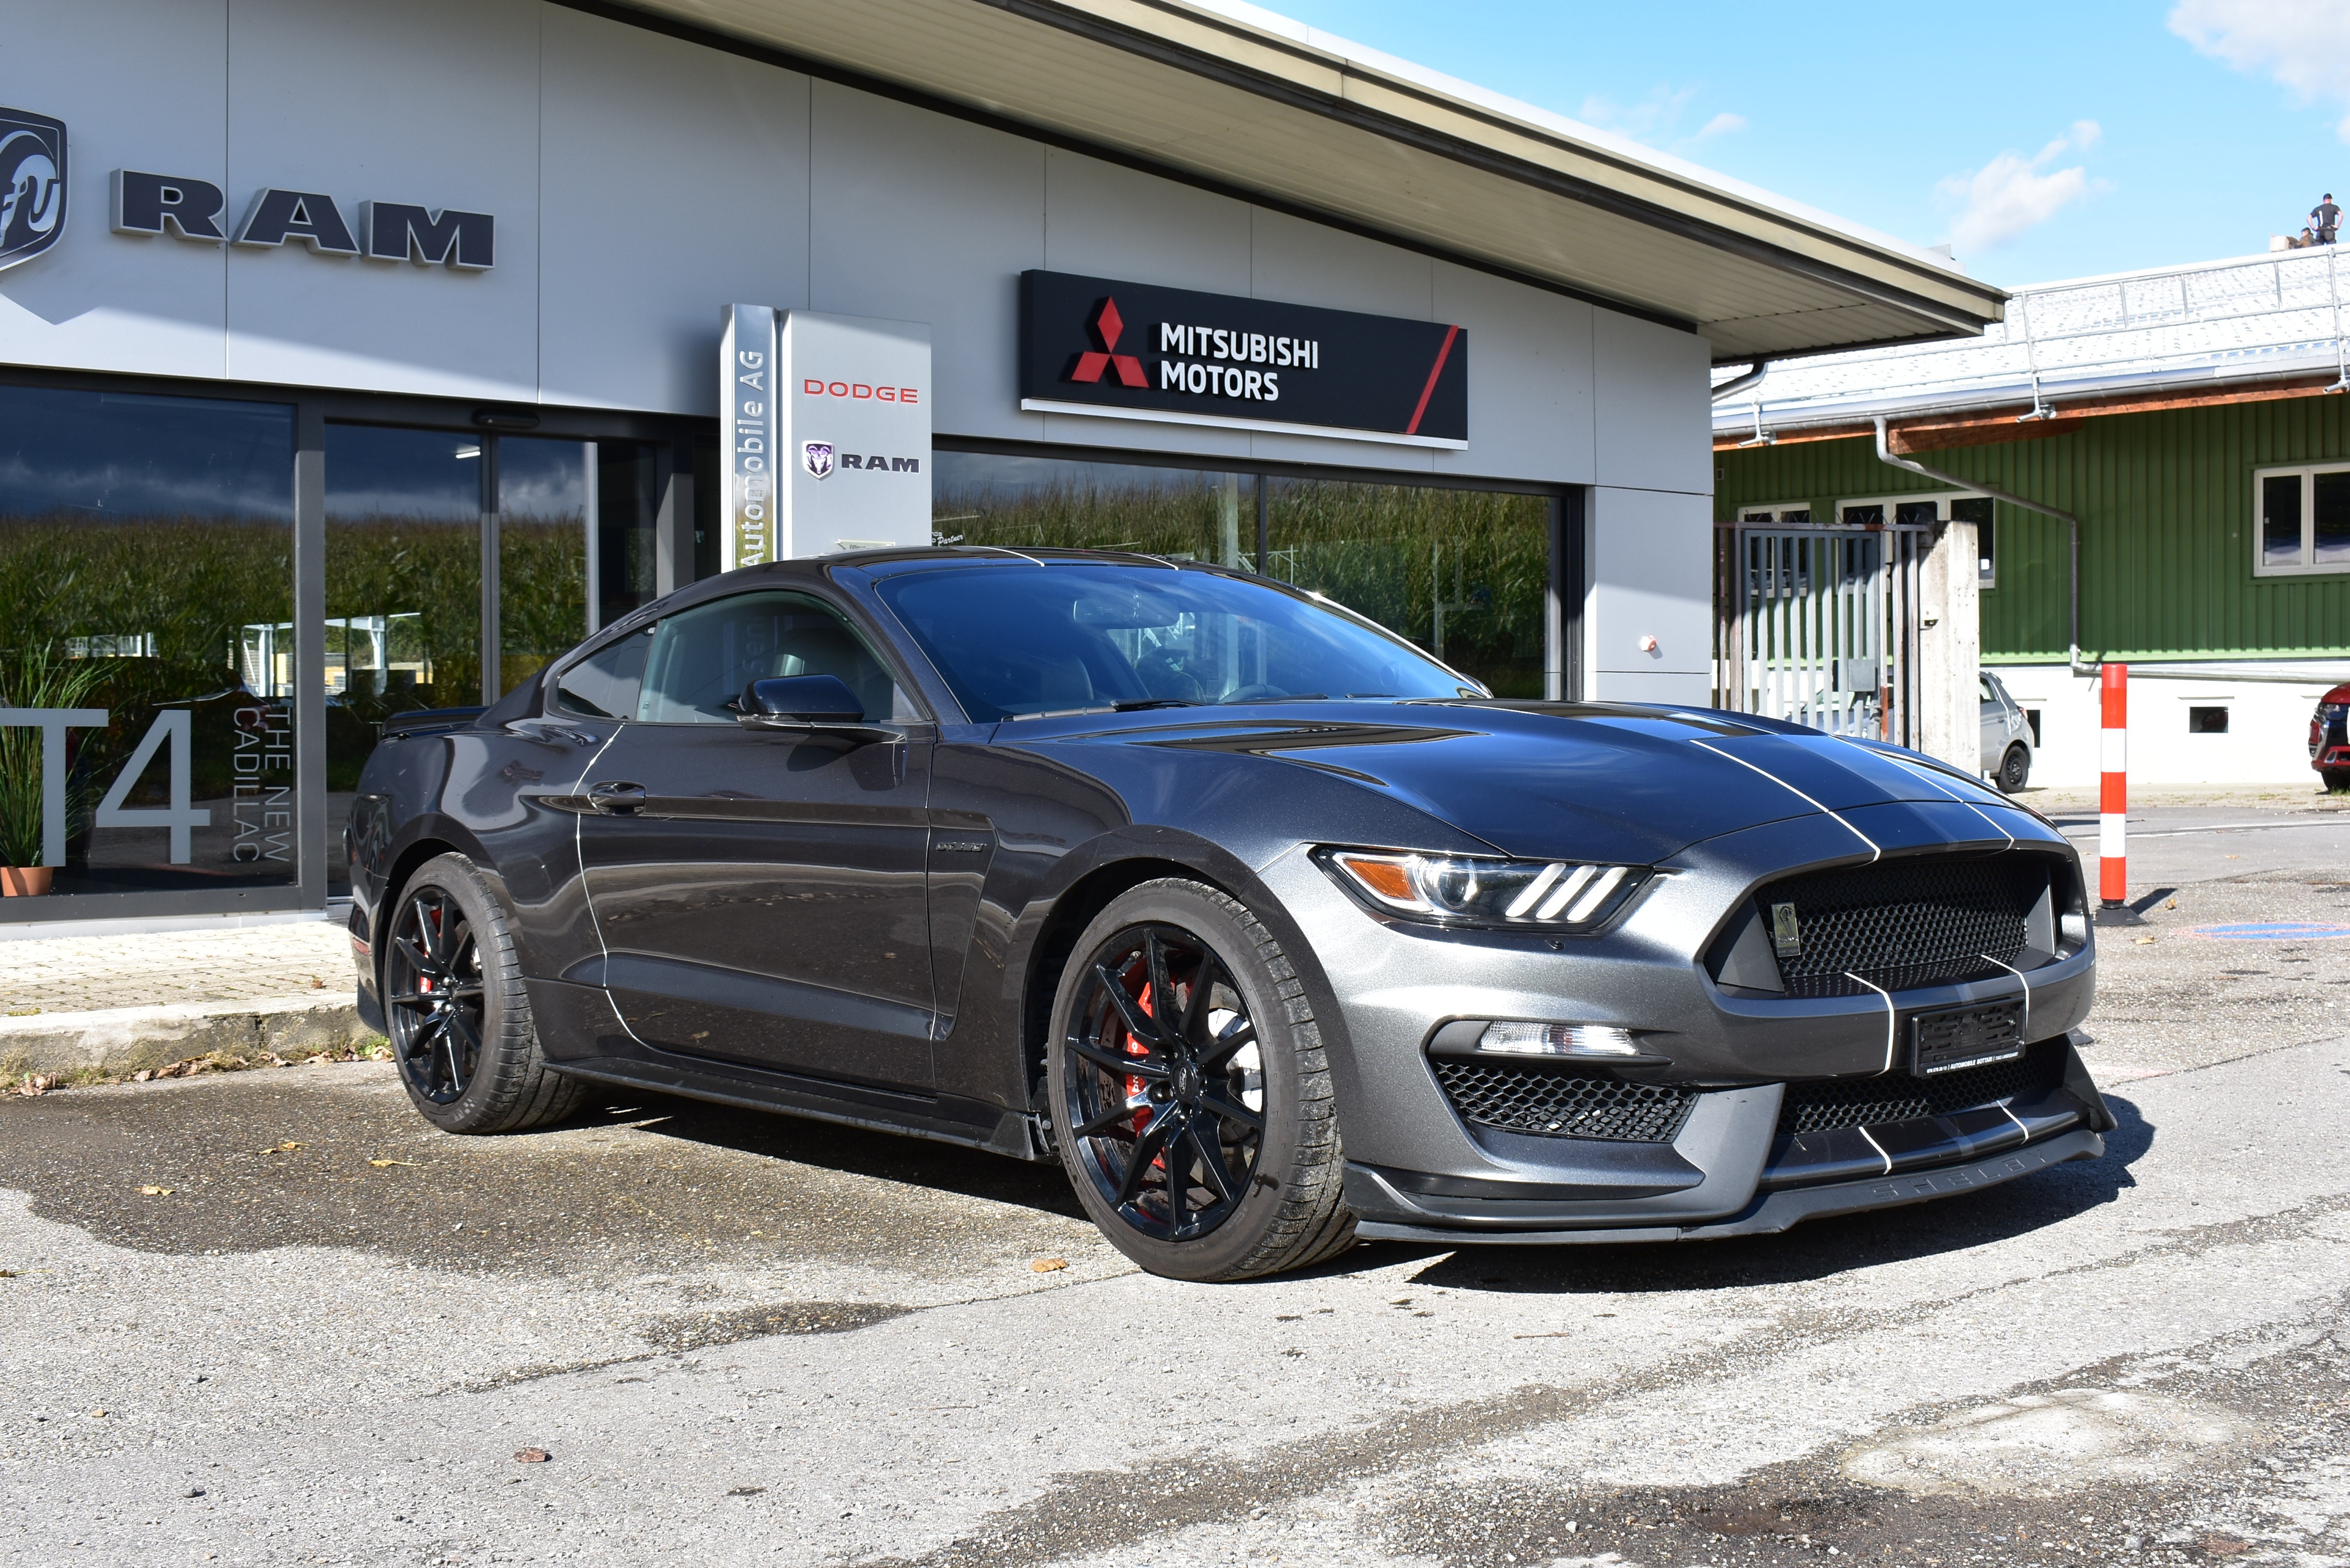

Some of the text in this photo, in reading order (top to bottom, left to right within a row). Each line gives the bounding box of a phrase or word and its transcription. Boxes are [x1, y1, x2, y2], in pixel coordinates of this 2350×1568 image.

[112, 168, 495, 271] RAM
[1161, 322, 1318, 369] MITSUBISHI
[804, 379, 918, 404] DODGE
[1161, 360, 1279, 401] MOTORS
[738, 351, 765, 566] Automobile AG
[841, 454, 919, 474] RAM
[937, 534, 964, 547] Partner
[234, 708, 260, 862] CADILLAC
[264, 707, 291, 862] THE NEW
[1950, 1059, 1976, 1070] AUTOMOBILE
[1977, 1056, 1993, 1065] BOTTARI
[1870, 1149, 2046, 1200] SHELBY
